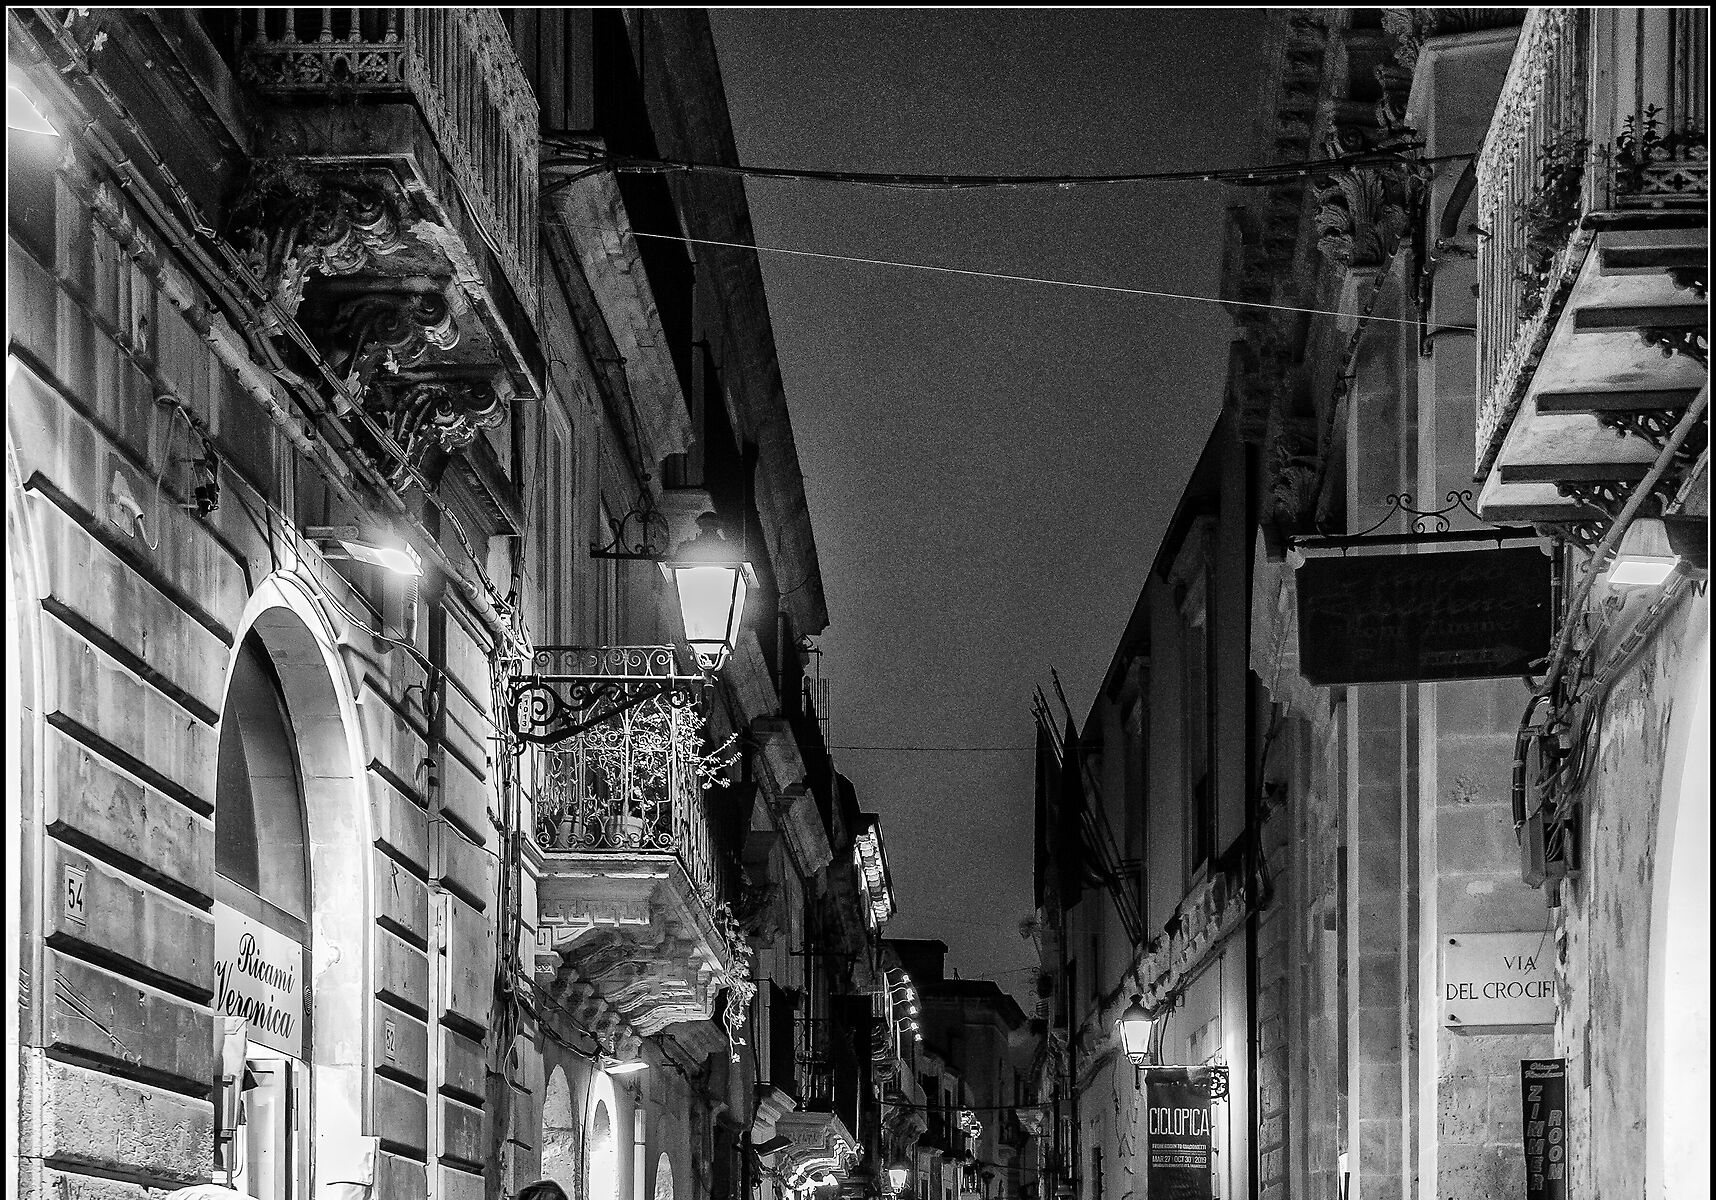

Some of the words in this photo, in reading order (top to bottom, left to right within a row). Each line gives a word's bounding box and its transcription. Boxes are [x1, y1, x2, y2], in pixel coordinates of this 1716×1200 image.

[68, 878, 83, 913] 54
[238, 932, 295, 994] Ricami
[1503, 956, 1537, 971] VIA
[214, 960, 295, 1039] Veronica
[1446, 982, 1478, 1000] DEL
[1150, 1107, 1210, 1136] CICLOPICA
[1527, 1085, 1546, 1190] ZIMMER
[1547, 1110, 1564, 1179] ROOM
